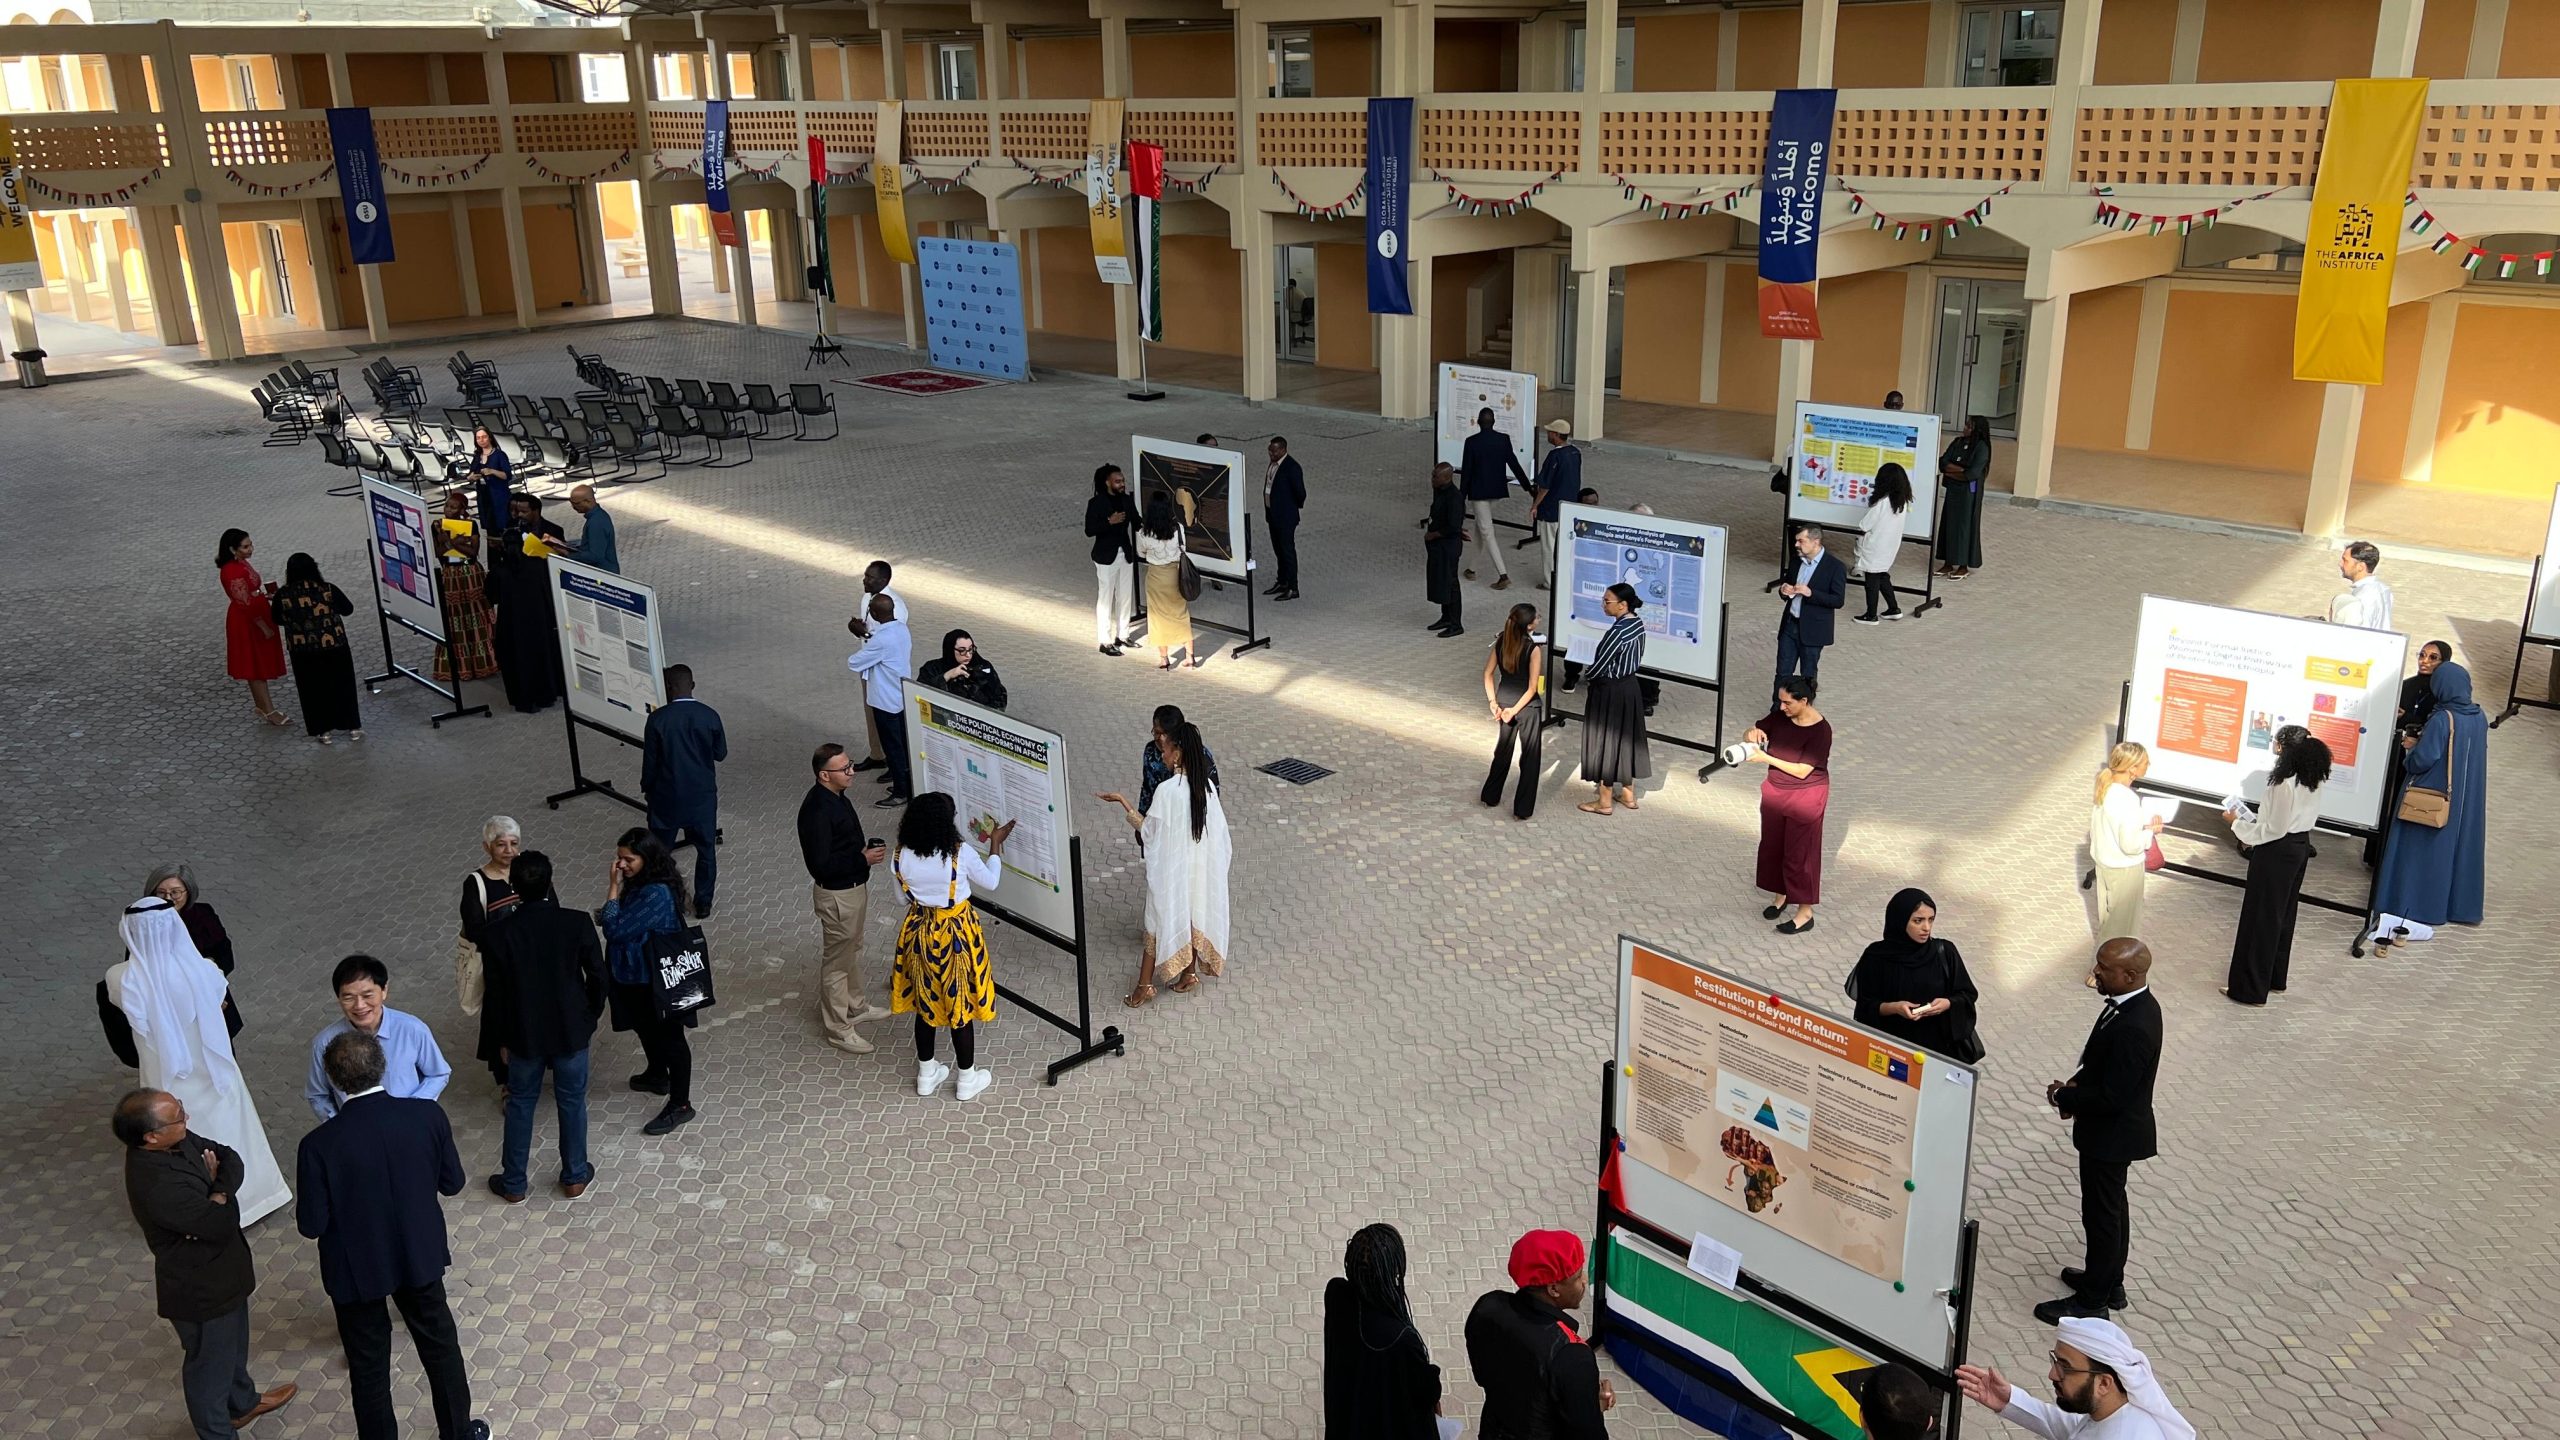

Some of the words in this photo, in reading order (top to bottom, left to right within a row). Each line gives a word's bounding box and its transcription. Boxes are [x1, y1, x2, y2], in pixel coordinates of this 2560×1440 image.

[716, 131, 725, 190] Welcome
[1, 156, 23, 228] WELCOME
[1107, 142, 1117, 220] WELCOME
[1794, 141, 1823, 245] Welcome
[2316, 250, 2338, 259] THE
[2338, 252, 2384, 260] AFRICA
[2320, 260, 2378, 270] INSTITUTE
[1595, 530, 1614, 539] Ethiopia
[1625, 534, 1644, 543] Kenya's
[1645, 537, 1663, 546] Foreign
[1664, 540, 1679, 549] Policy
[1606, 524, 1637, 535] Comparative
[1638, 530, 1658, 538] Analysis
[947, 720, 982, 738] ECONOMIC
[983, 734, 1013, 751] REFORMS
[1015, 744, 1022, 753] IN
[1023, 749, 1047, 763] AFRICA
[956, 714, 967, 723] THE
[968, 718, 1000, 736] POLITICAL
[1002, 731, 1036, 750] ECONOMY
[1661, 1001, 1679, 1010] question
[1694, 975, 1754, 1008] Restitution
[1758, 1001, 1801, 1026] Beyond
[1804, 1018, 1848, 1045] Return:
[1694, 989, 1717, 1003] Toward
[1727, 1003, 1747, 1015] Ethics
[1756, 1014, 1778, 1028] Repair
[1787, 1027, 1812, 1042] African
[1813, 1037, 1847, 1055] Museums
[1719, 1022, 1748, 1039] Methodology
[1818, 1072, 1834, 1082] results
[1819, 1064, 1845, 1080] Preliminary
[1847, 1076, 1866, 1089] findings
[1873, 1088, 1898, 1101] expected
[1810, 1163, 1818, 1171] Key
[1819, 1168, 1848, 1184] implications
[1856, 1184, 1890, 1200] contributions
